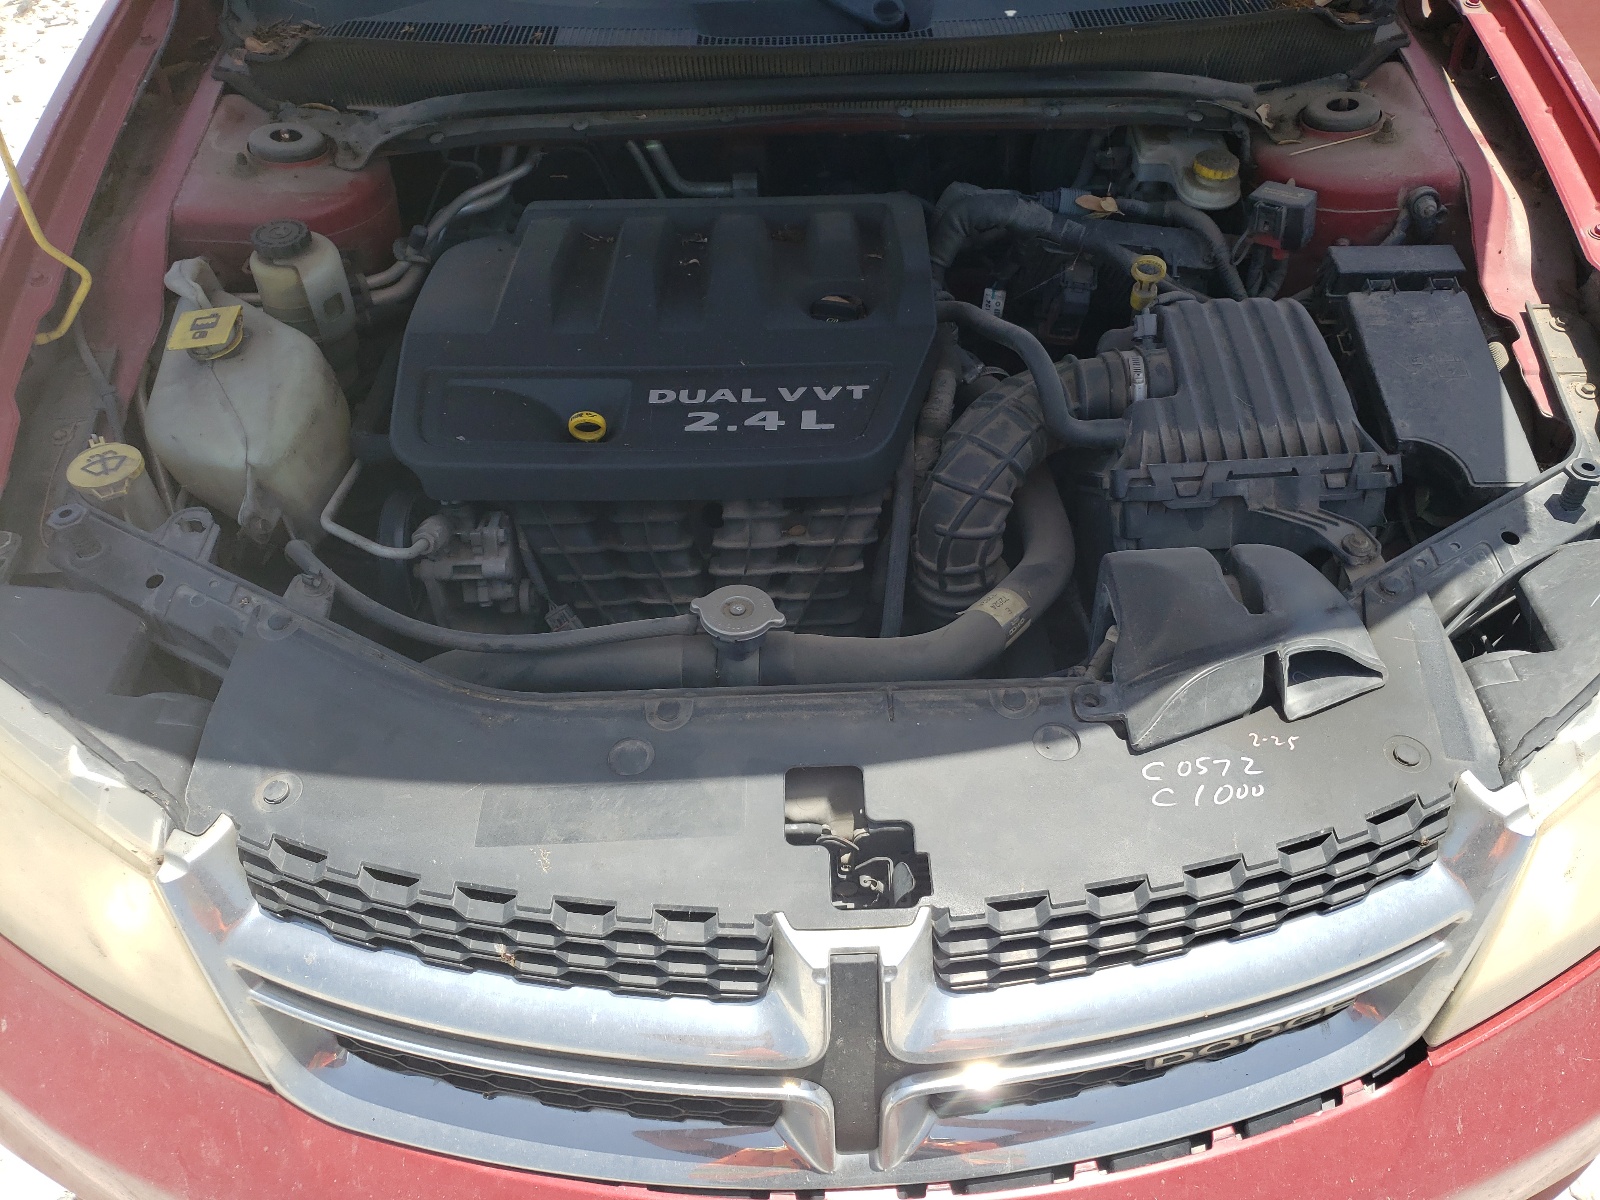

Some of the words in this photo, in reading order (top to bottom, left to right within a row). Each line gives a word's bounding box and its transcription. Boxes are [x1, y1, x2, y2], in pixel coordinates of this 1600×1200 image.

[648, 388, 767, 404] DUAL
[777, 384, 870, 401] VVT
[684, 410, 786, 432] 2.4
[800, 409, 835, 430] L
[1248, 732, 1299, 751] 2-25
[1176, 756, 1264, 777] 0572
[1194, 784, 1265, 807] 1000
